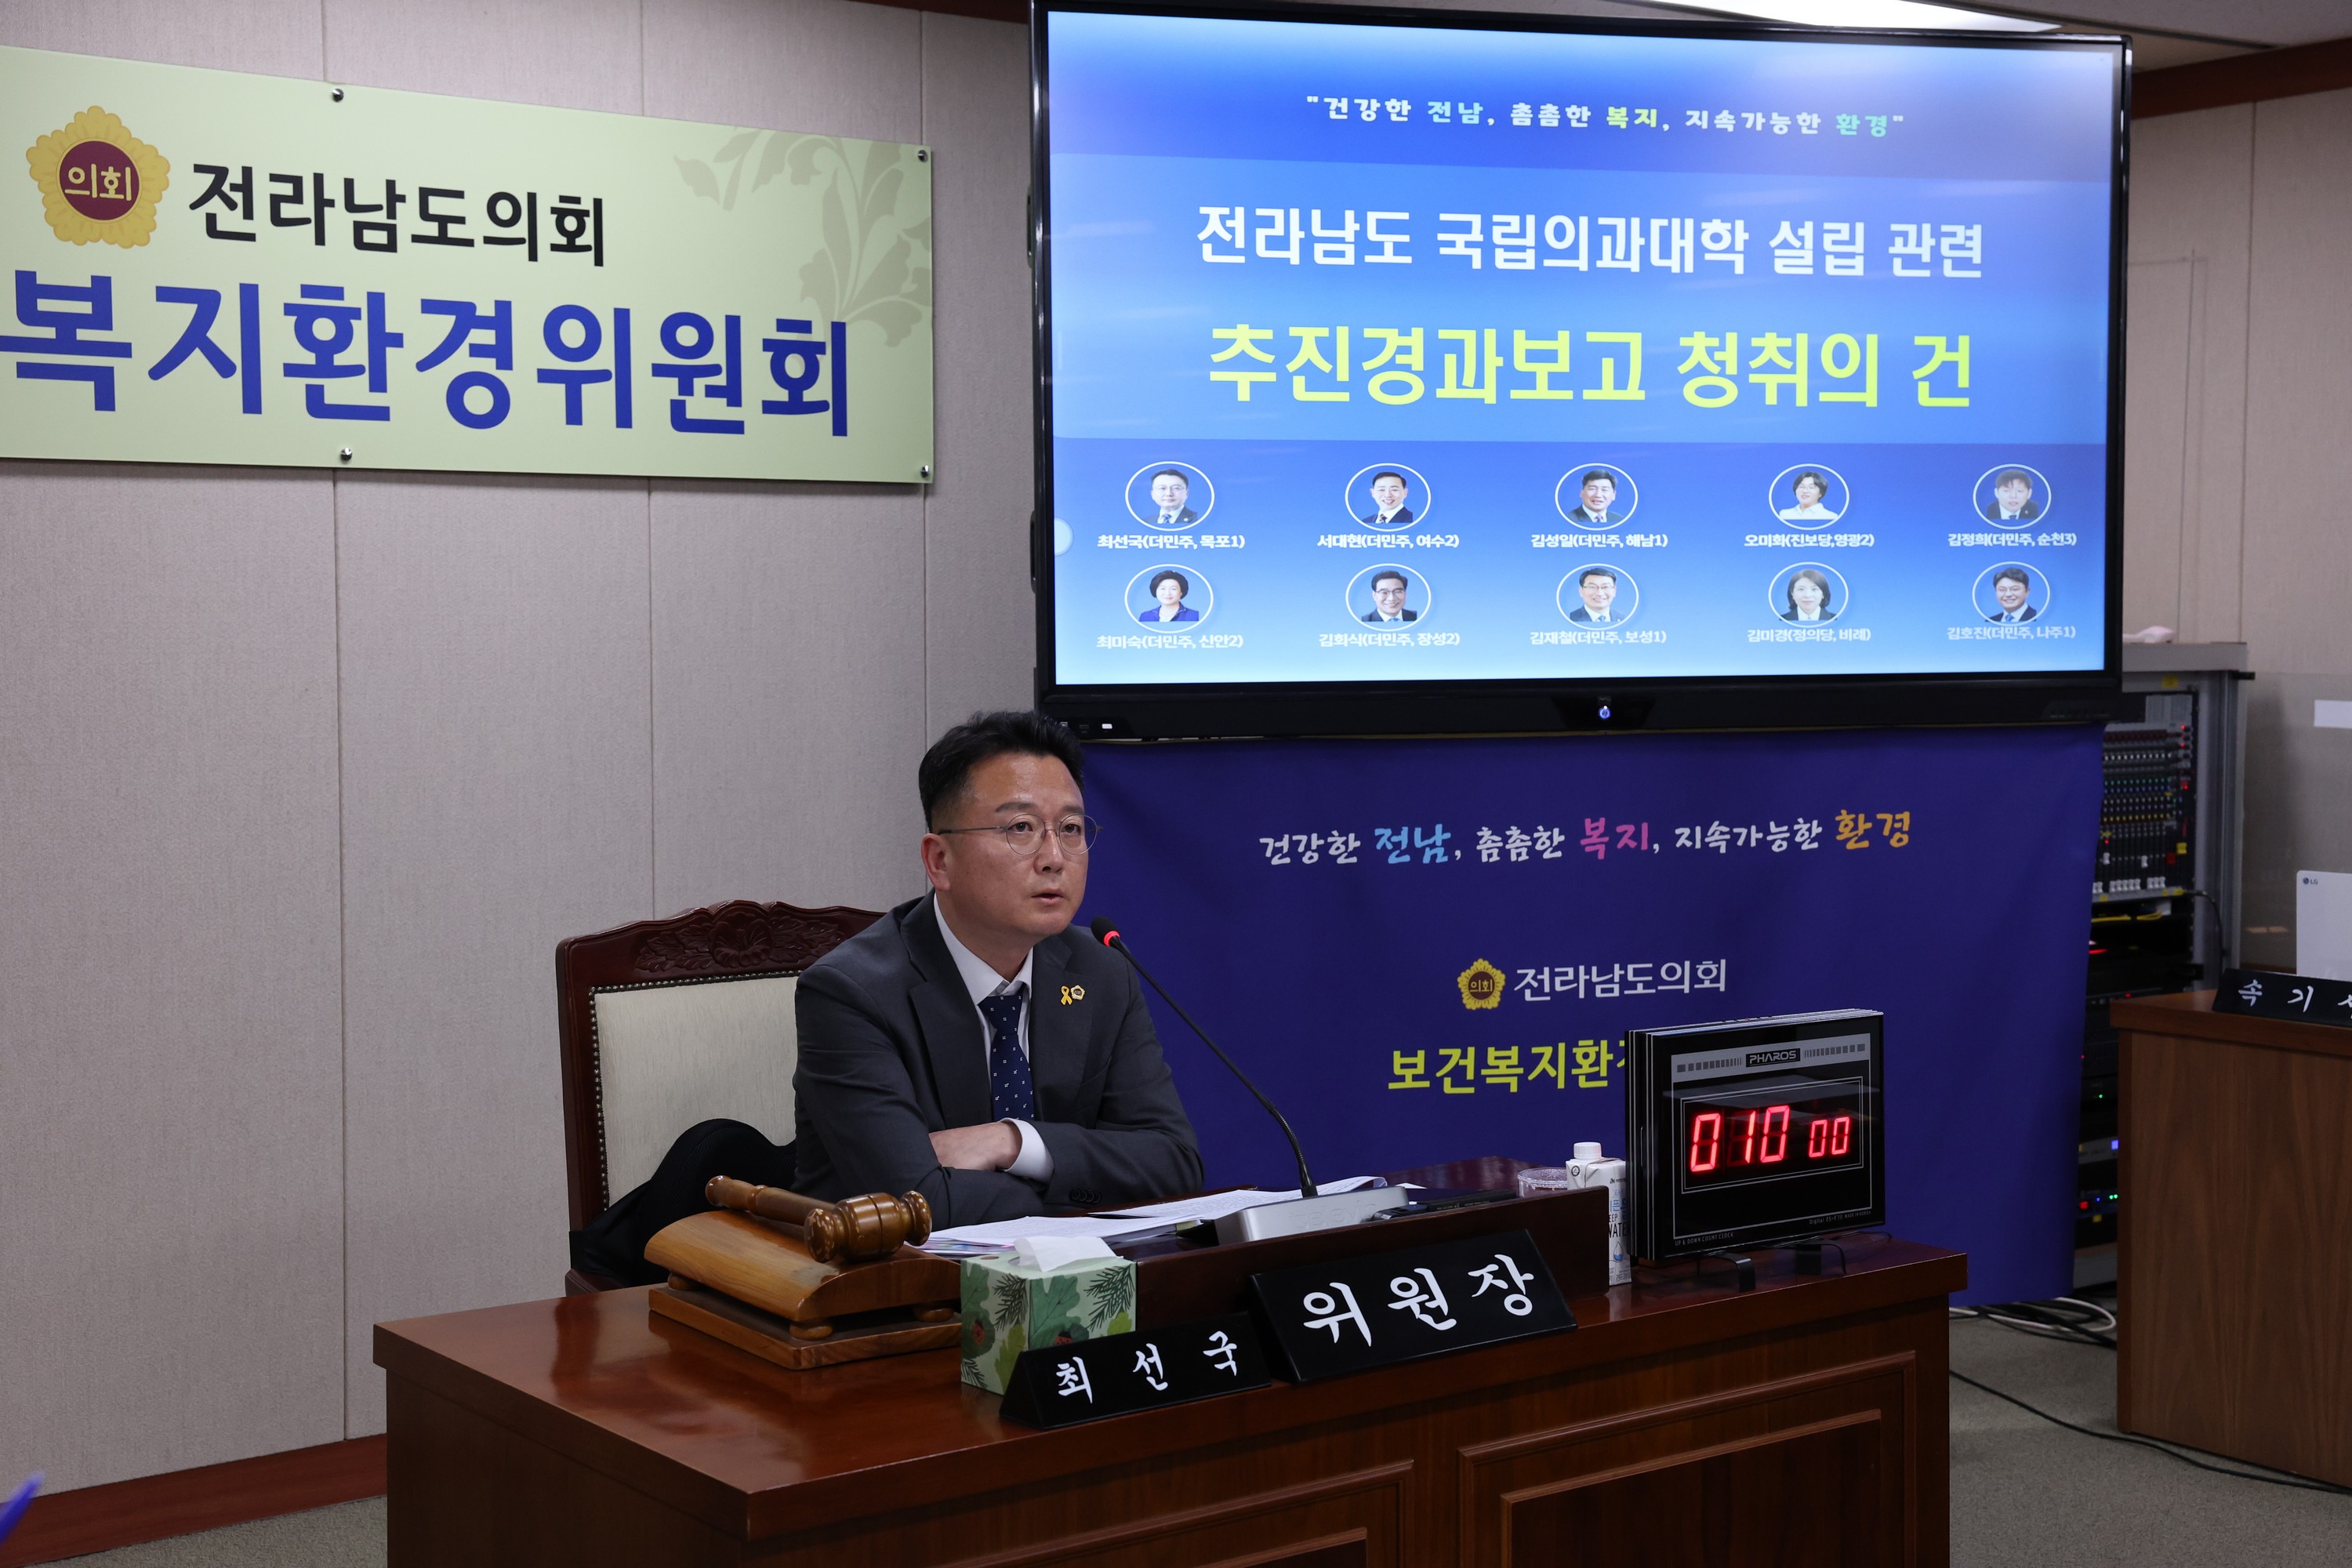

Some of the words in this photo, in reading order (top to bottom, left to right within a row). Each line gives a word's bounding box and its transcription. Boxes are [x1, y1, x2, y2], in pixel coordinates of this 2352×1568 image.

[1306, 96, 1412, 122] "건강한
[1427, 100, 1495, 126] 전남,
[1510, 102, 1592, 128] 촘촘한
[1606, 106, 1670, 132] 복지,
[1685, 109, 1822, 135] 지속가능한
[1835, 112, 1904, 138] 환경"
[64, 162, 134, 202] 의회
[188, 162, 604, 267] 전라남도의회
[1196, 205, 1414, 267] 전라남도
[1436, 212, 1750, 275] 국립의과대학
[1769, 220, 1866, 277] 설립
[1887, 223, 1984, 279] 관련
[0, 267, 848, 437] 복지환경위원회
[1208, 322, 1646, 405] 추진경과보고
[1676, 330, 1879, 408] 청취의
[1911, 334, 1971, 408] 건
[1097, 534, 1198, 550] 최선국(더민주,
[1200, 534, 1246, 549] 목포1)
[1317, 534, 1414, 550] 서대현(더민주,
[1416, 534, 1460, 549] 여수2)
[1530, 533, 1624, 549] 김성일(더민주,
[1625, 534, 1668, 548] 해남1)
[1947, 532, 2036, 547] 김정희(더민주,
[2038, 532, 2077, 546] 순천3)
[1096, 634, 1197, 650] 최미숙(더민주,
[1199, 634, 1244, 649] 신안2)
[1417, 633, 1461, 647] 장성2)
[1530, 630, 1623, 645] 김재철(더민주,
[1624, 630, 1667, 644] 보성1)
[1747, 628, 1837, 643] 김미경(정의당,
[1839, 628, 1871, 642] 비례)
[1947, 626, 2034, 641] 김호진(더민주,
[2037, 626, 2077, 639] 나주1)
[1259, 829, 1361, 866] 건강한
[1374, 823, 1461, 864] 전남,
[1476, 825, 1565, 862] 촘촘한
[1580, 817, 1660, 860] 복지,
[1674, 817, 1823, 854] 지속가능한
[1835, 808, 1911, 851] 환경
[1469, 978, 1494, 993] 의회
[1513, 959, 1726, 1002] 전라남도의회
[1388, 1039, 1625, 1094] 보건복지환
[1749, 1050, 1797, 1065] PHAROS
[1690, 1104, 1791, 1174] 010
[1808, 1116, 1851, 1159] 00
[1302, 1254, 1534, 1347] 위원장
